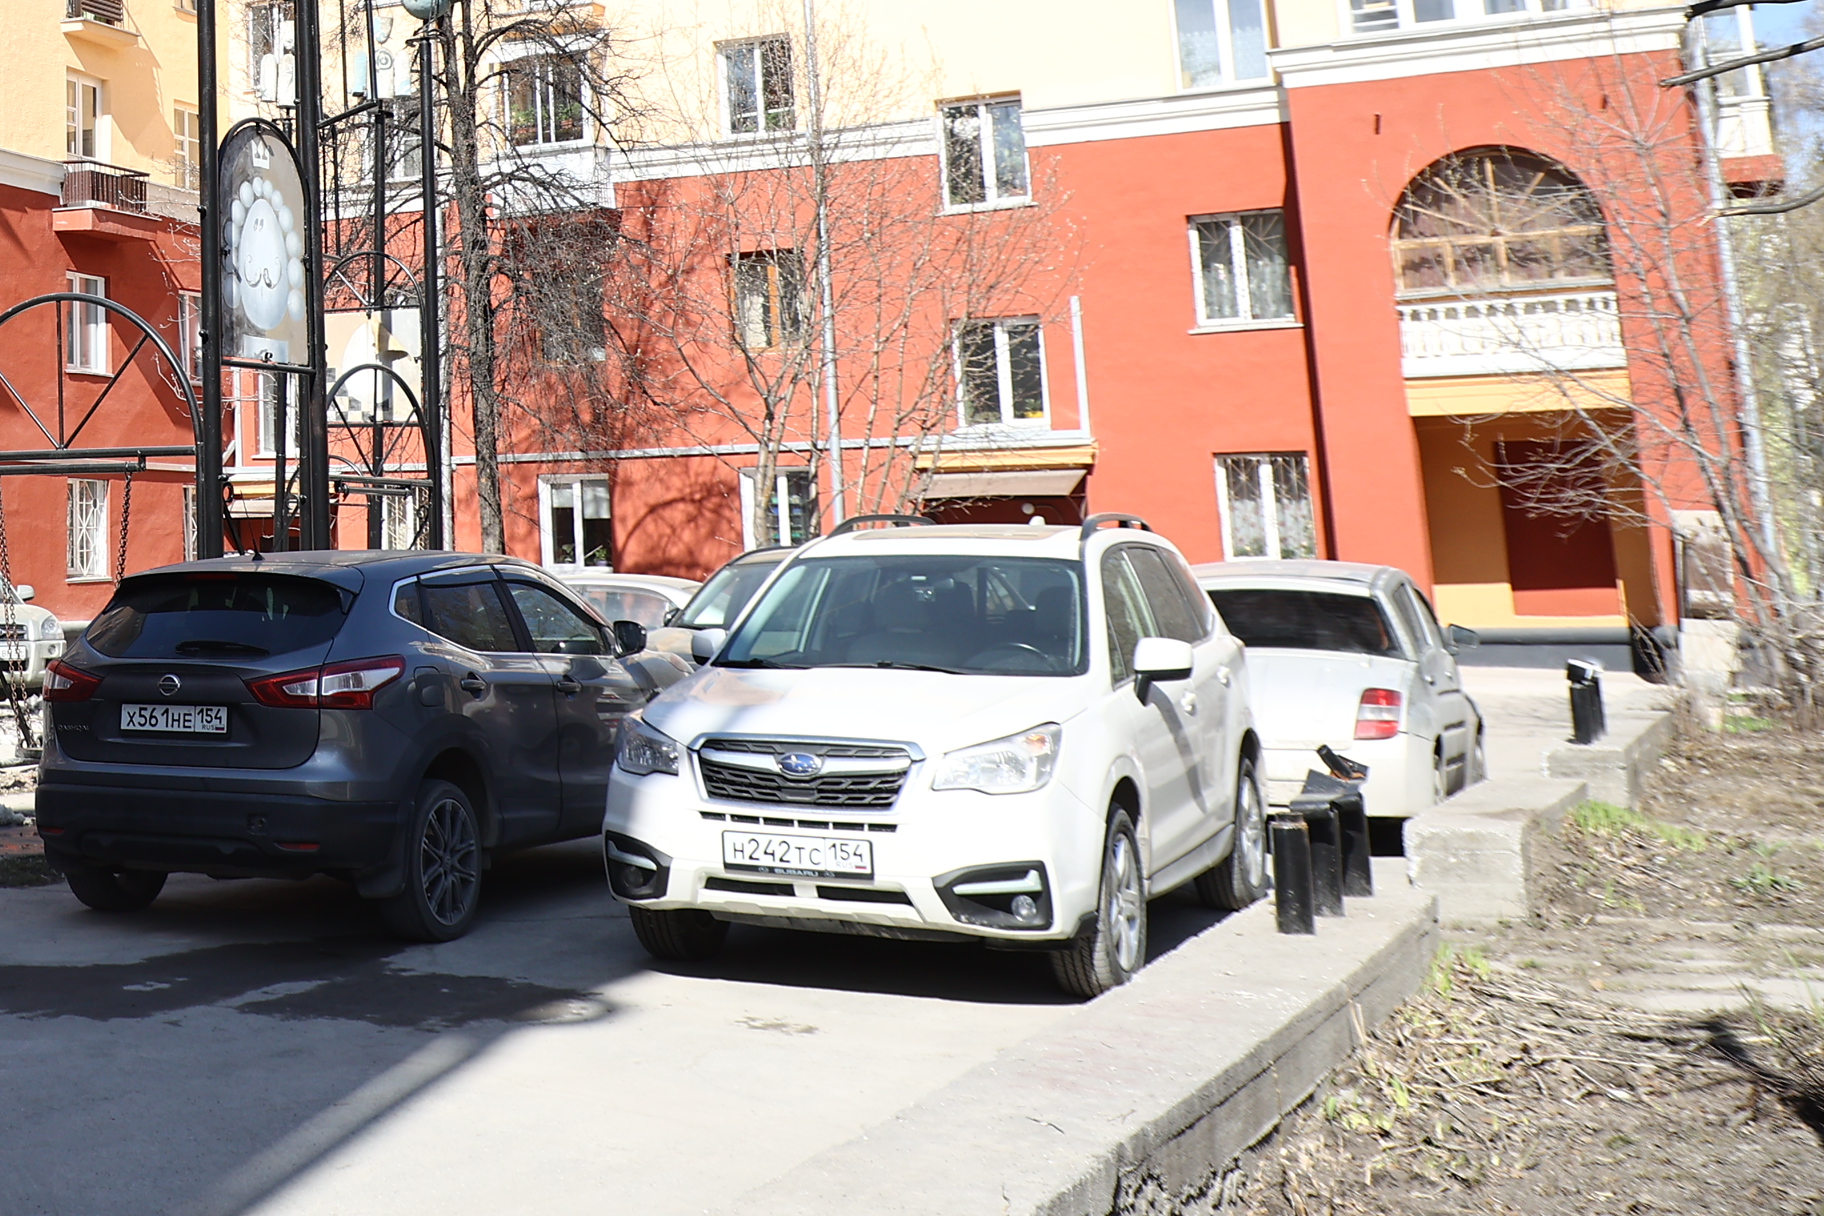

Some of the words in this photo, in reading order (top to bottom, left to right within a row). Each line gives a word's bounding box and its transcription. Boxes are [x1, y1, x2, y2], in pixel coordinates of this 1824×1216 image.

[197, 708, 223, 725] 154
[828, 843, 864, 863] 154
[835, 861, 854, 869] RUS
[774, 868, 819, 877] SUBARU
